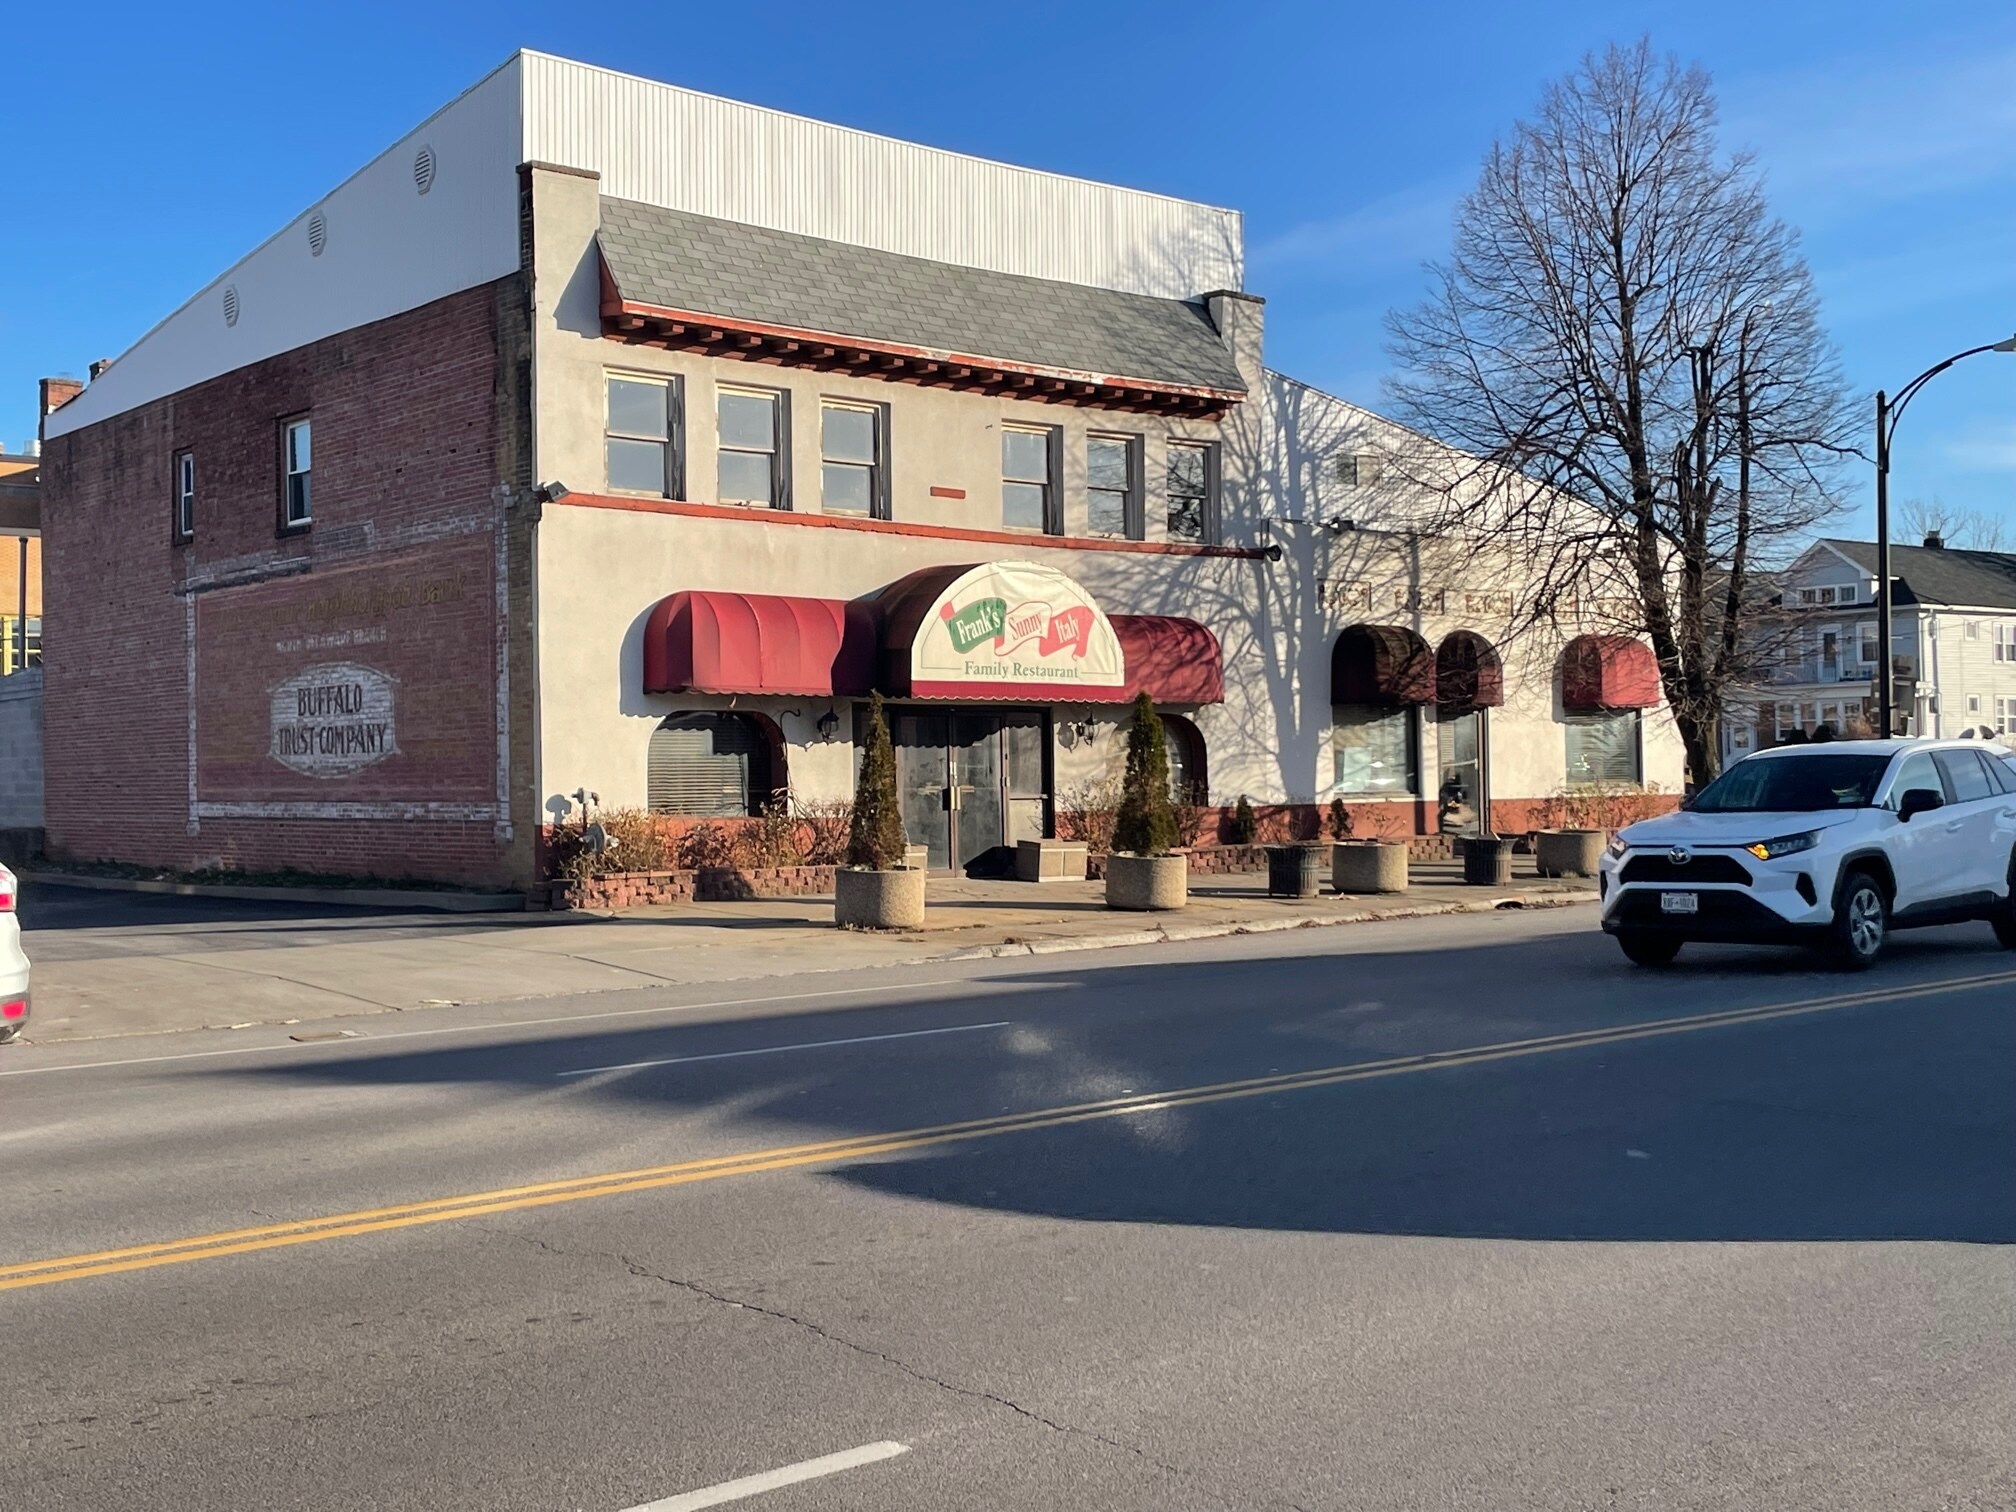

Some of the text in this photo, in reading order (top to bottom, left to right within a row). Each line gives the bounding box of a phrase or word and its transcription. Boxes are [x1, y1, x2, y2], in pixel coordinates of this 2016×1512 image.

[956, 607, 1080, 644] Frank's Sunny Italy
[964, 661, 1078, 679] Family Restaurant
[297, 684, 362, 717] BUFFALO
[278, 723, 387, 756] TRUST COMPANY
